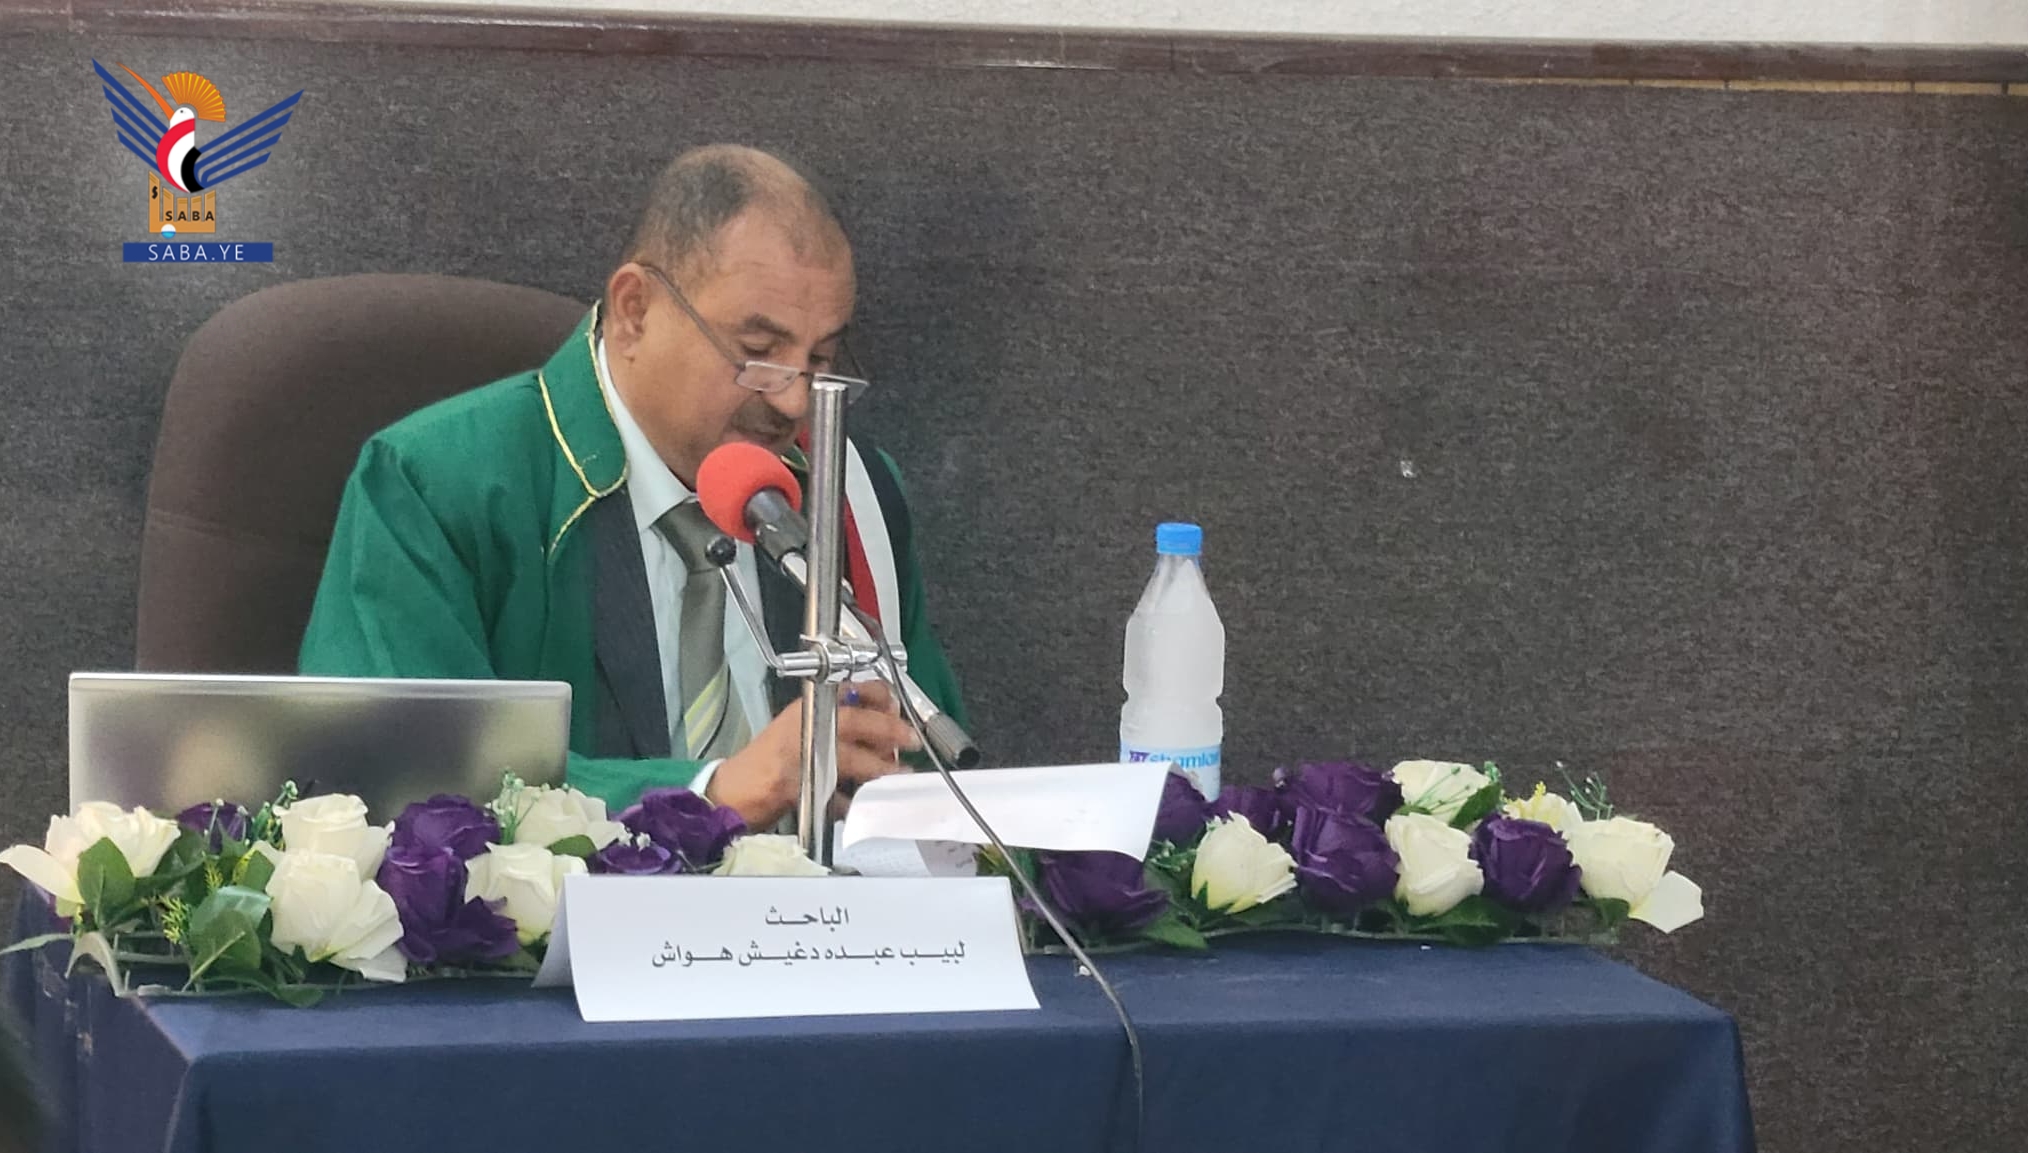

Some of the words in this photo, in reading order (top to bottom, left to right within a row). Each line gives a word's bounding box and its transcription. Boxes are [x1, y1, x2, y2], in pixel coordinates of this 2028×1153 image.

[764, 905, 849, 931] الباحث
[651, 940, 734, 969] هواش
[738, 939, 821, 967] دغيش
[824, 944, 897, 967] عبده
[899, 940, 966, 967] لبيب
